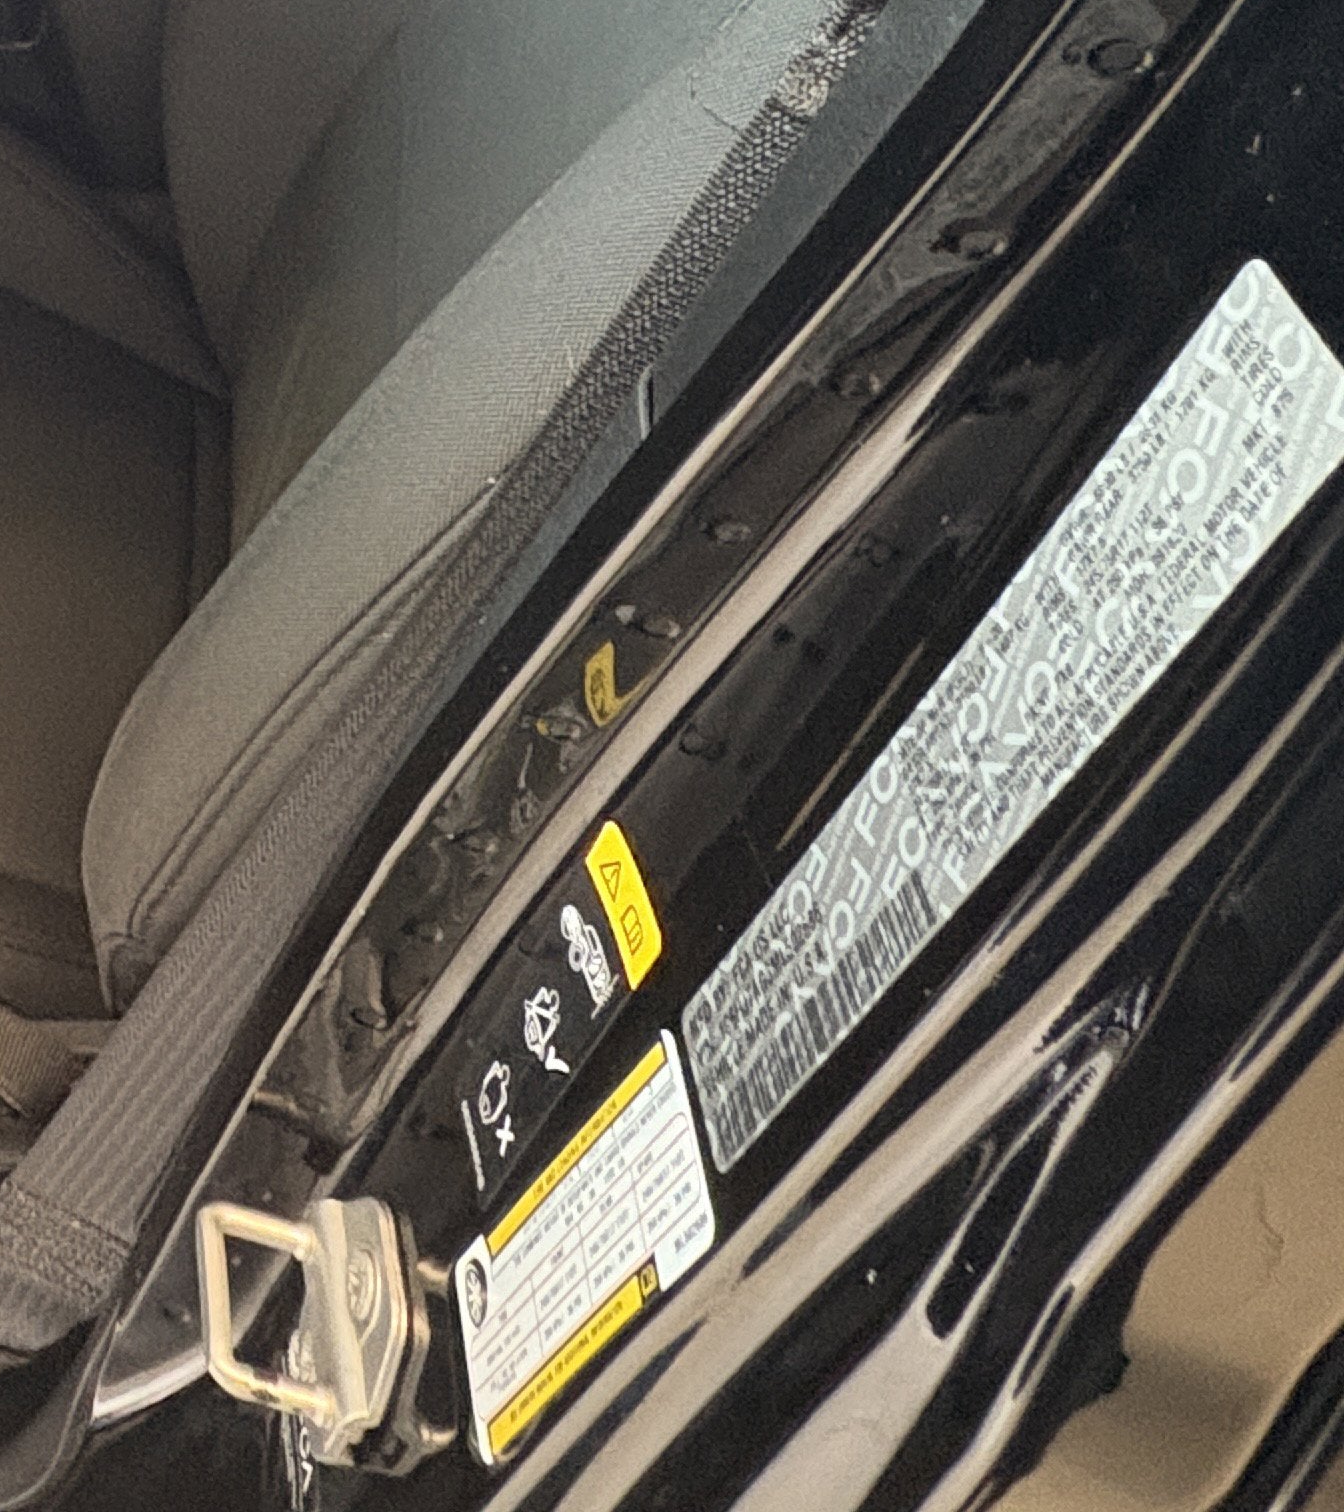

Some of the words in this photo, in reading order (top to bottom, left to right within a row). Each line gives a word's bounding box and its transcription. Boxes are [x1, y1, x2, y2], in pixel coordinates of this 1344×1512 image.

[1223, 319, 1250, 358] WITH
[1232, 335, 1258, 372] RIMS
[1242, 346, 1273, 388] TIRES
[1253, 366, 1281, 405] COLD
[1205, 484, 1242, 533] MOTOR
